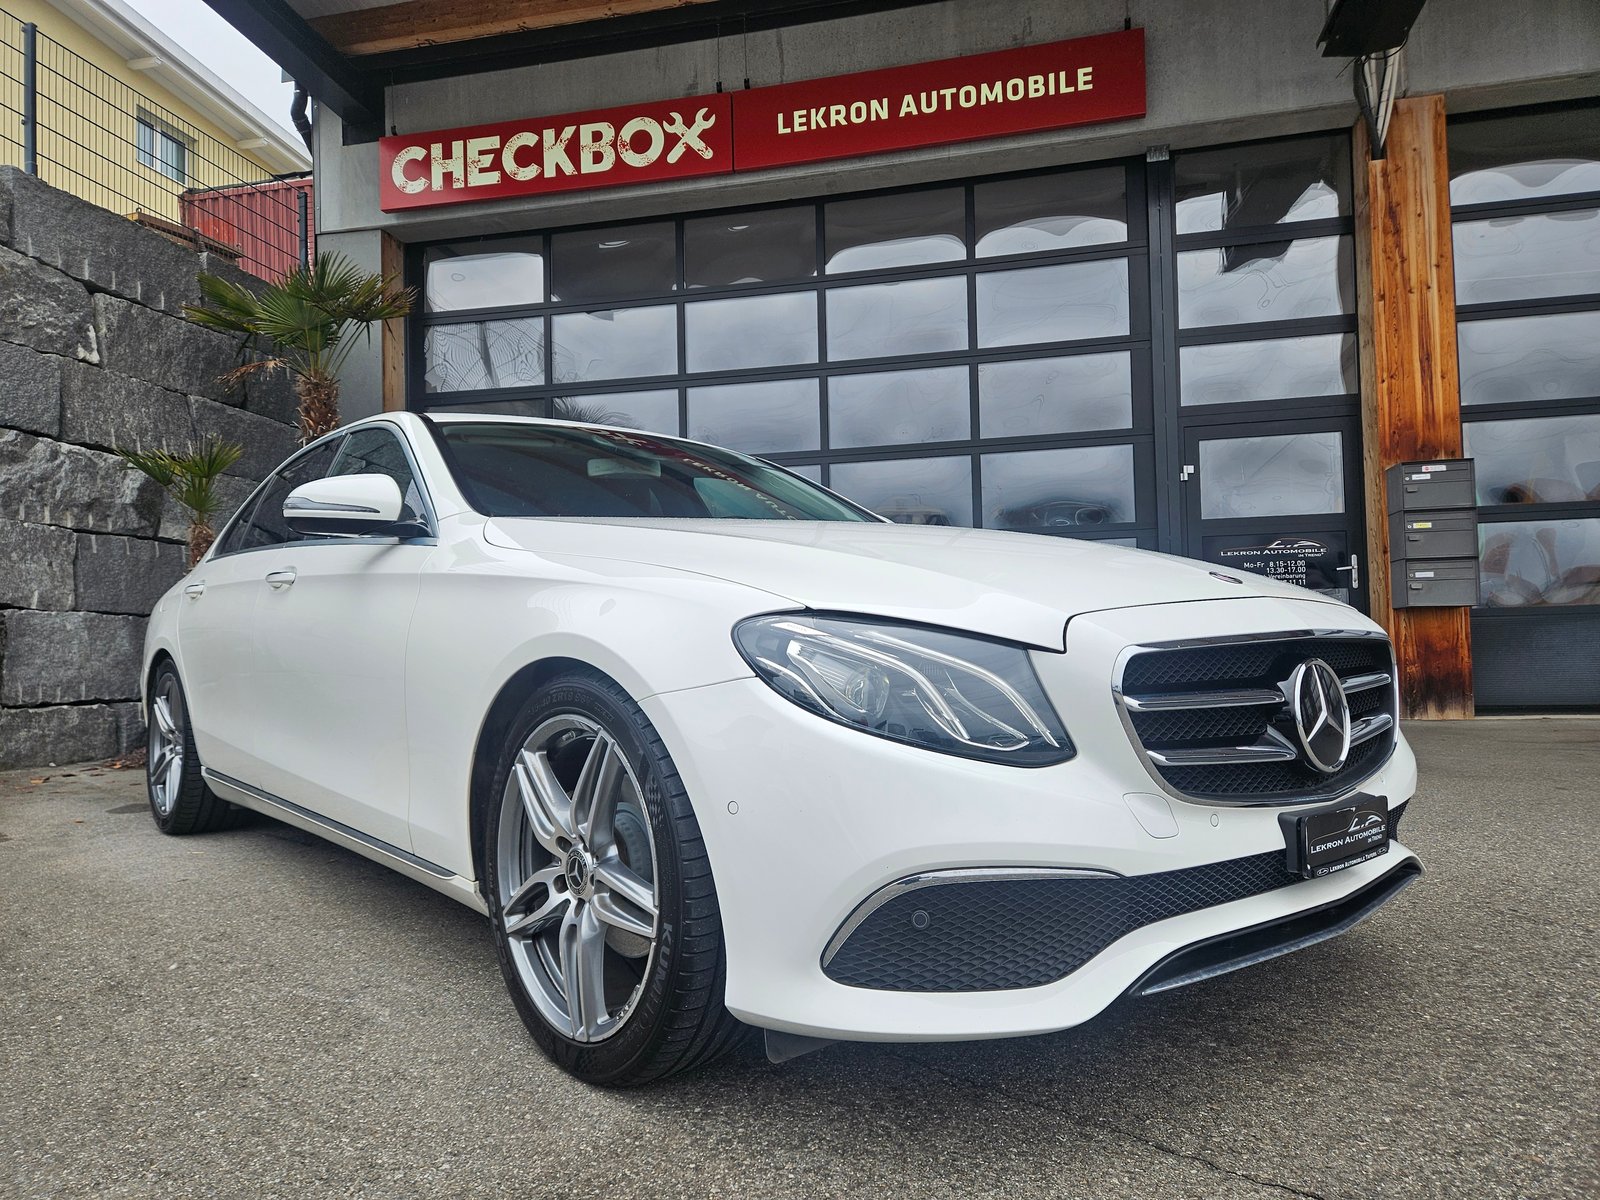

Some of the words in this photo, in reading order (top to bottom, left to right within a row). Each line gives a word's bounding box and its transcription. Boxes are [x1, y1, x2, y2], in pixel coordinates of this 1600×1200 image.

[776, 98, 889, 135] LEKRON
[898, 67, 1094, 118] AUTOMOBILE
[1263, 548, 1327, 556] AUTOMOBILE
[1243, 561, 1265, 569] Mo-Fr
[1269, 560, 1306, 568] 8.15-12.00
[1311, 839, 1344, 854] LEKRON
[1344, 825, 1386, 845] AUTOMOBILE
